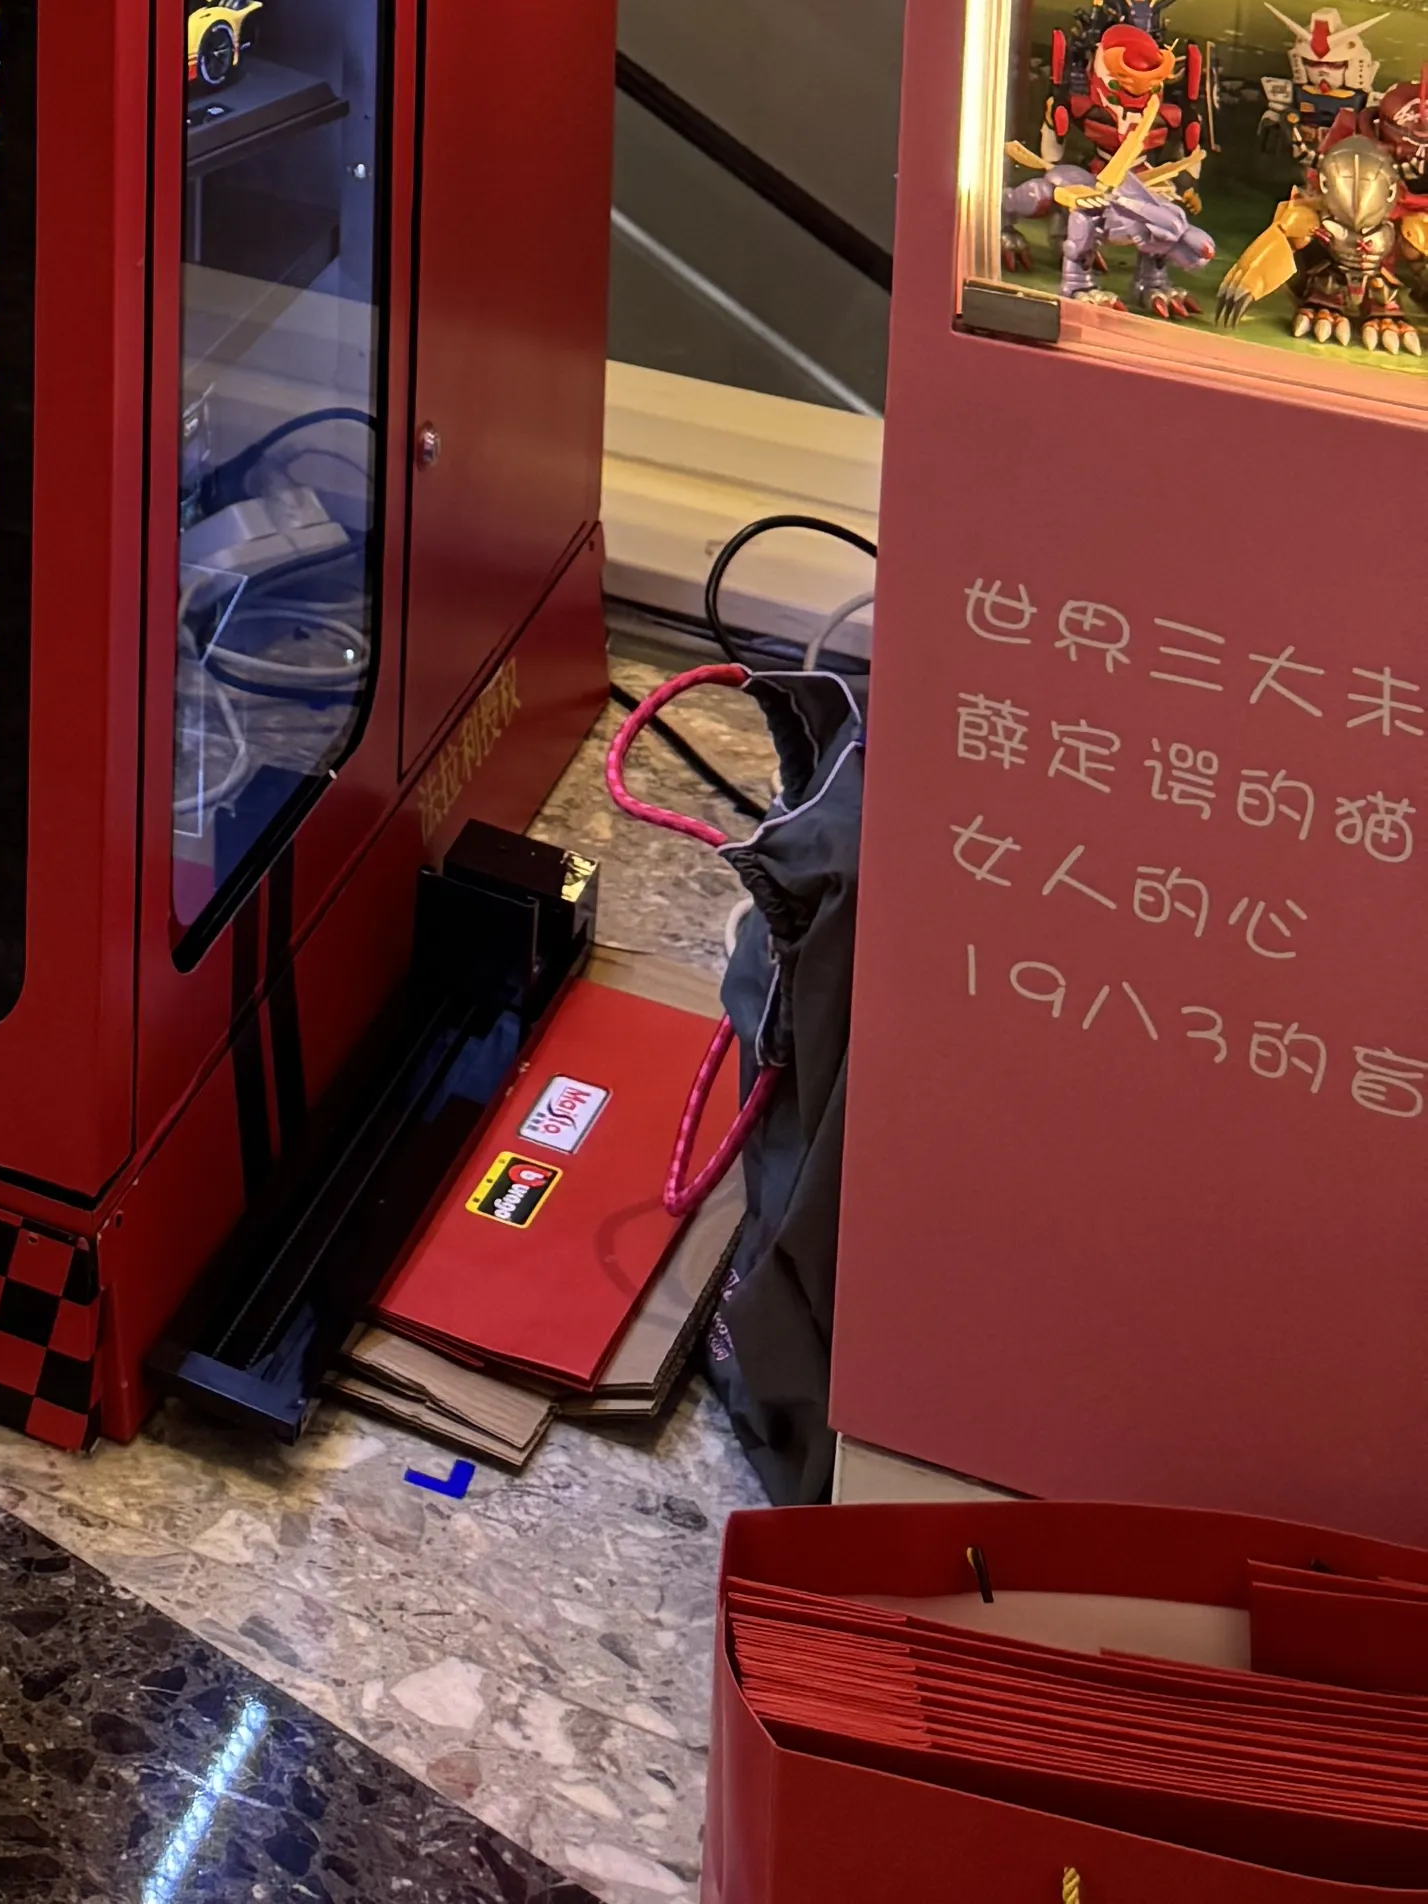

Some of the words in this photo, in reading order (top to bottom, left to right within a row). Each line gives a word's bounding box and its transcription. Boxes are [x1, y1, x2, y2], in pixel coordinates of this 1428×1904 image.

[963, 577, 1426, 737] 世界三大未
[956, 692, 1417, 864] 薛定谔的猫
[949, 814, 1308, 960] 女人的心
